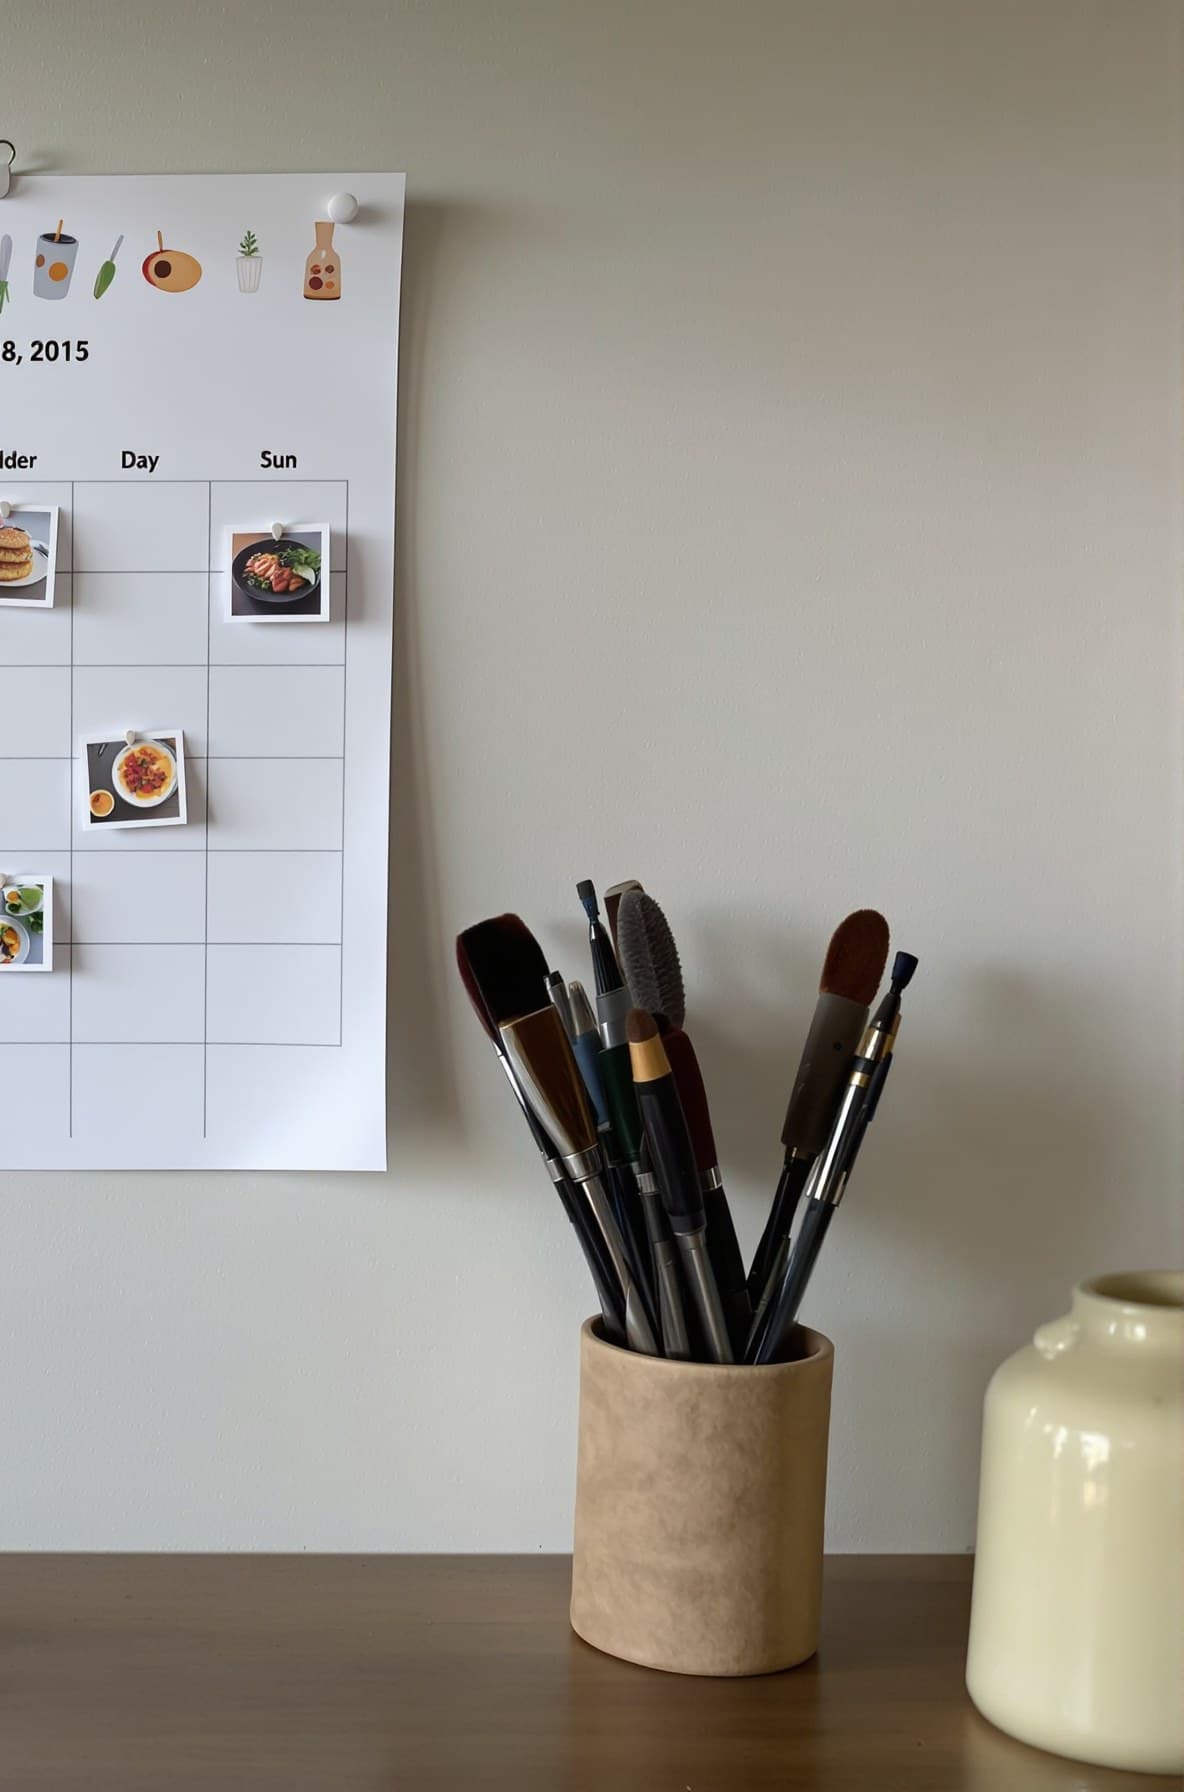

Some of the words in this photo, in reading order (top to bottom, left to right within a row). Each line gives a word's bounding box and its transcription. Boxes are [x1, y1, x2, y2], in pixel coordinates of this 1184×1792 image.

[30, 340, 89, 363] 2015
[121, 450, 160, 475] Day
[260, 450, 297, 470] Sun
